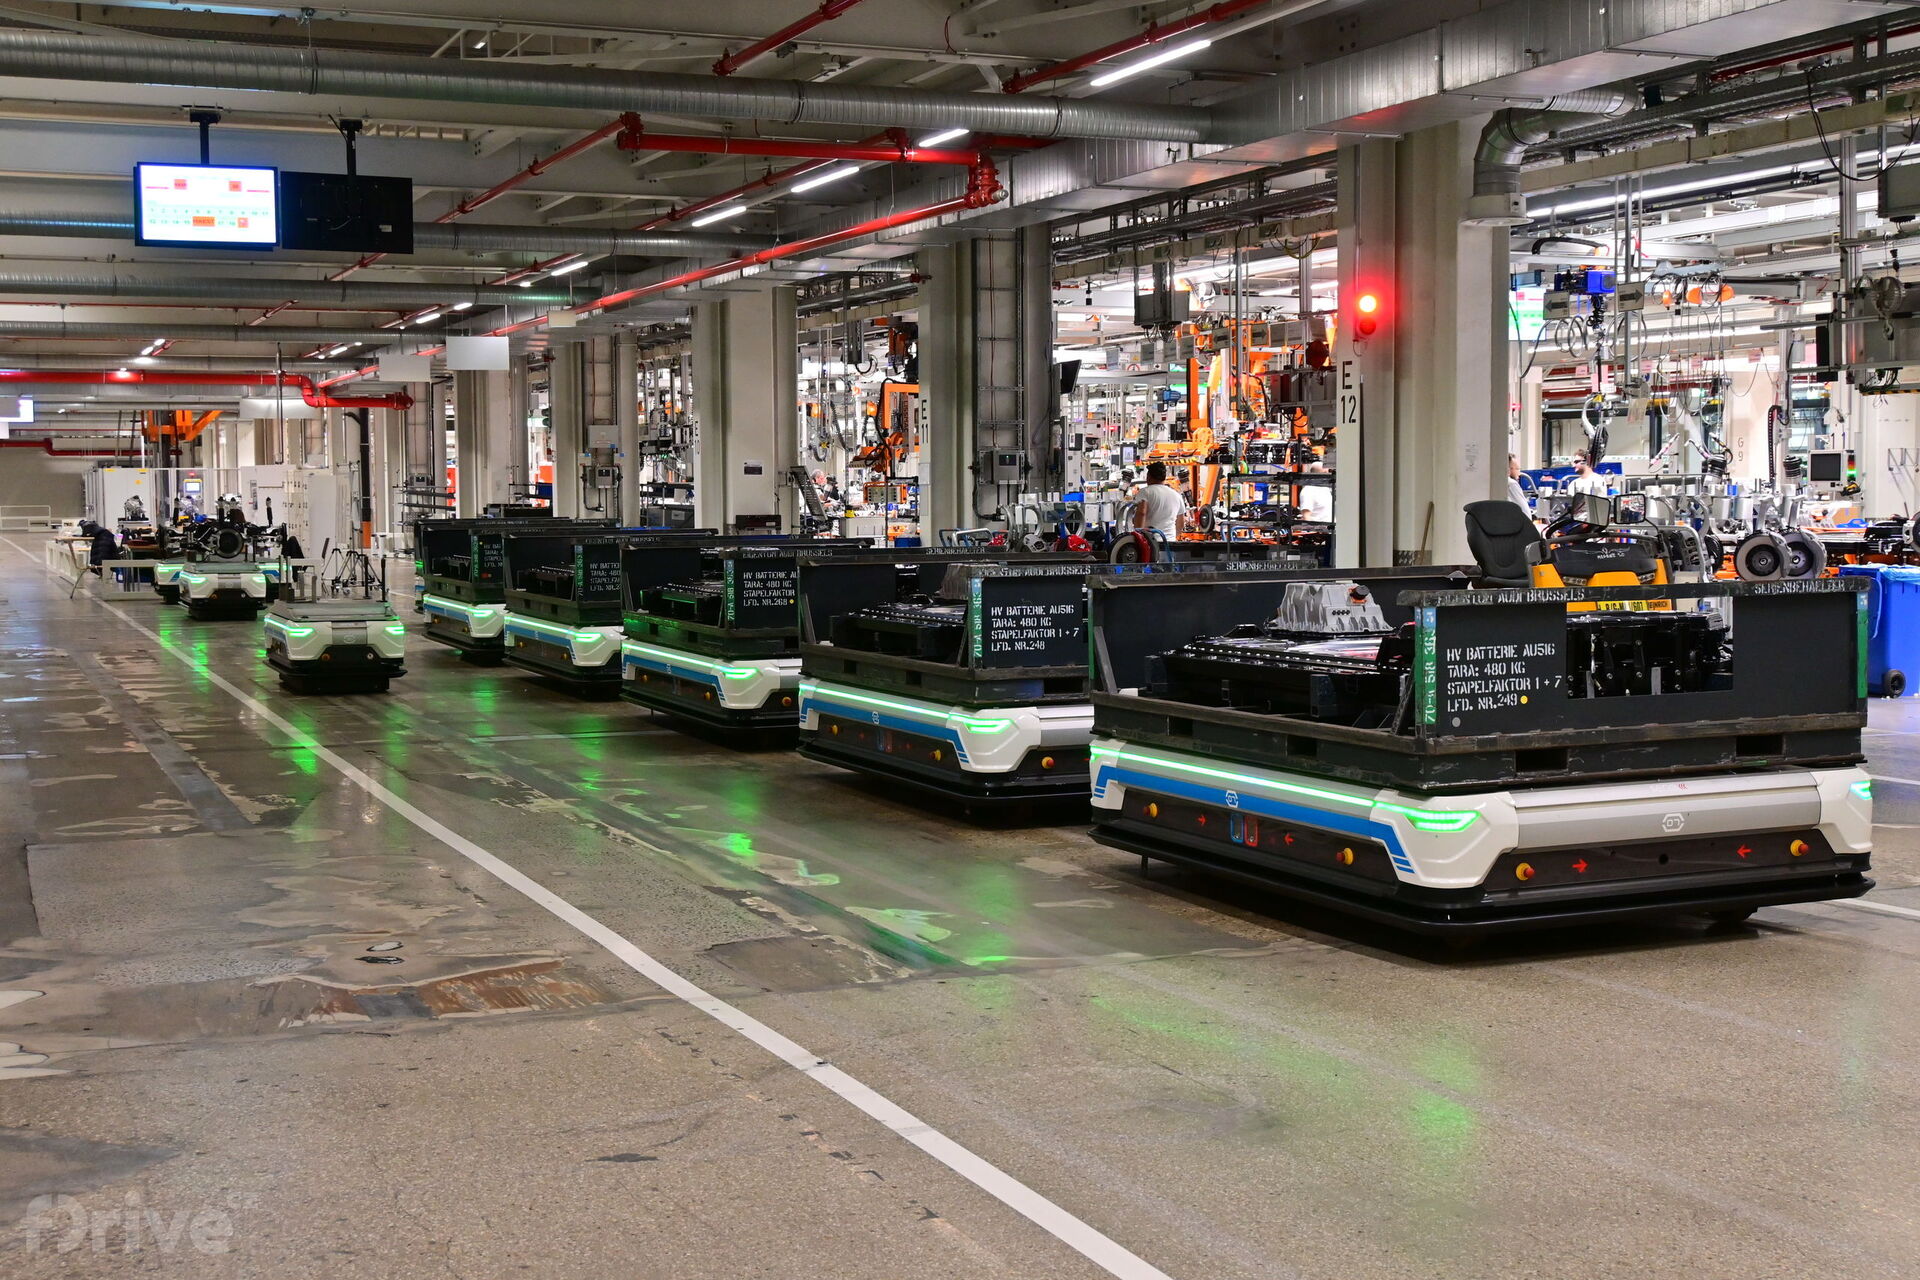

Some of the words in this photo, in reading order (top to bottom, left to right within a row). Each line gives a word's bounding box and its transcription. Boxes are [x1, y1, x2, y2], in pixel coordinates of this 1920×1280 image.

[1342, 361, 1352, 390] E
[922, 400, 927, 420] E
[1341, 395, 1356, 424] 12
[922, 423, 928, 444] 11
[1738, 437, 1744, 448] G
[1738, 450, 1743, 462] 9
[743, 589, 795, 598] STAPELFAKTOR
[1527, 588, 1585, 602] BRUSSELS
[991, 606, 1002, 616] HV
[1006, 606, 1046, 616] BATTERIE
[1050, 605, 1074, 615] AU516
[992, 618, 1016, 628] TARA:
[1020, 618, 1037, 626] 480
[1040, 617, 1052, 626] KG
[992, 628, 1055, 640] STAPELFAKTOR
[1073, 628, 1080, 637] 7
[991, 642, 1011, 651] LFD.
[1014, 640, 1045, 650] NR.248
[1447, 648, 1462, 662] HV
[1467, 645, 1518, 660] BATTERIE
[1523, 643, 1555, 657] AU516
[1448, 664, 1479, 678] TARA:
[1484, 662, 1506, 675] 480
[1511, 661, 1525, 674] KG
[1448, 678, 1531, 695] STAPELFAKTOR
[1535, 677, 1539, 690] 1
[1554, 675, 1562, 688] 7
[1448, 698, 1473, 712] LFD.
[1478, 693, 1518, 710] NR.249
